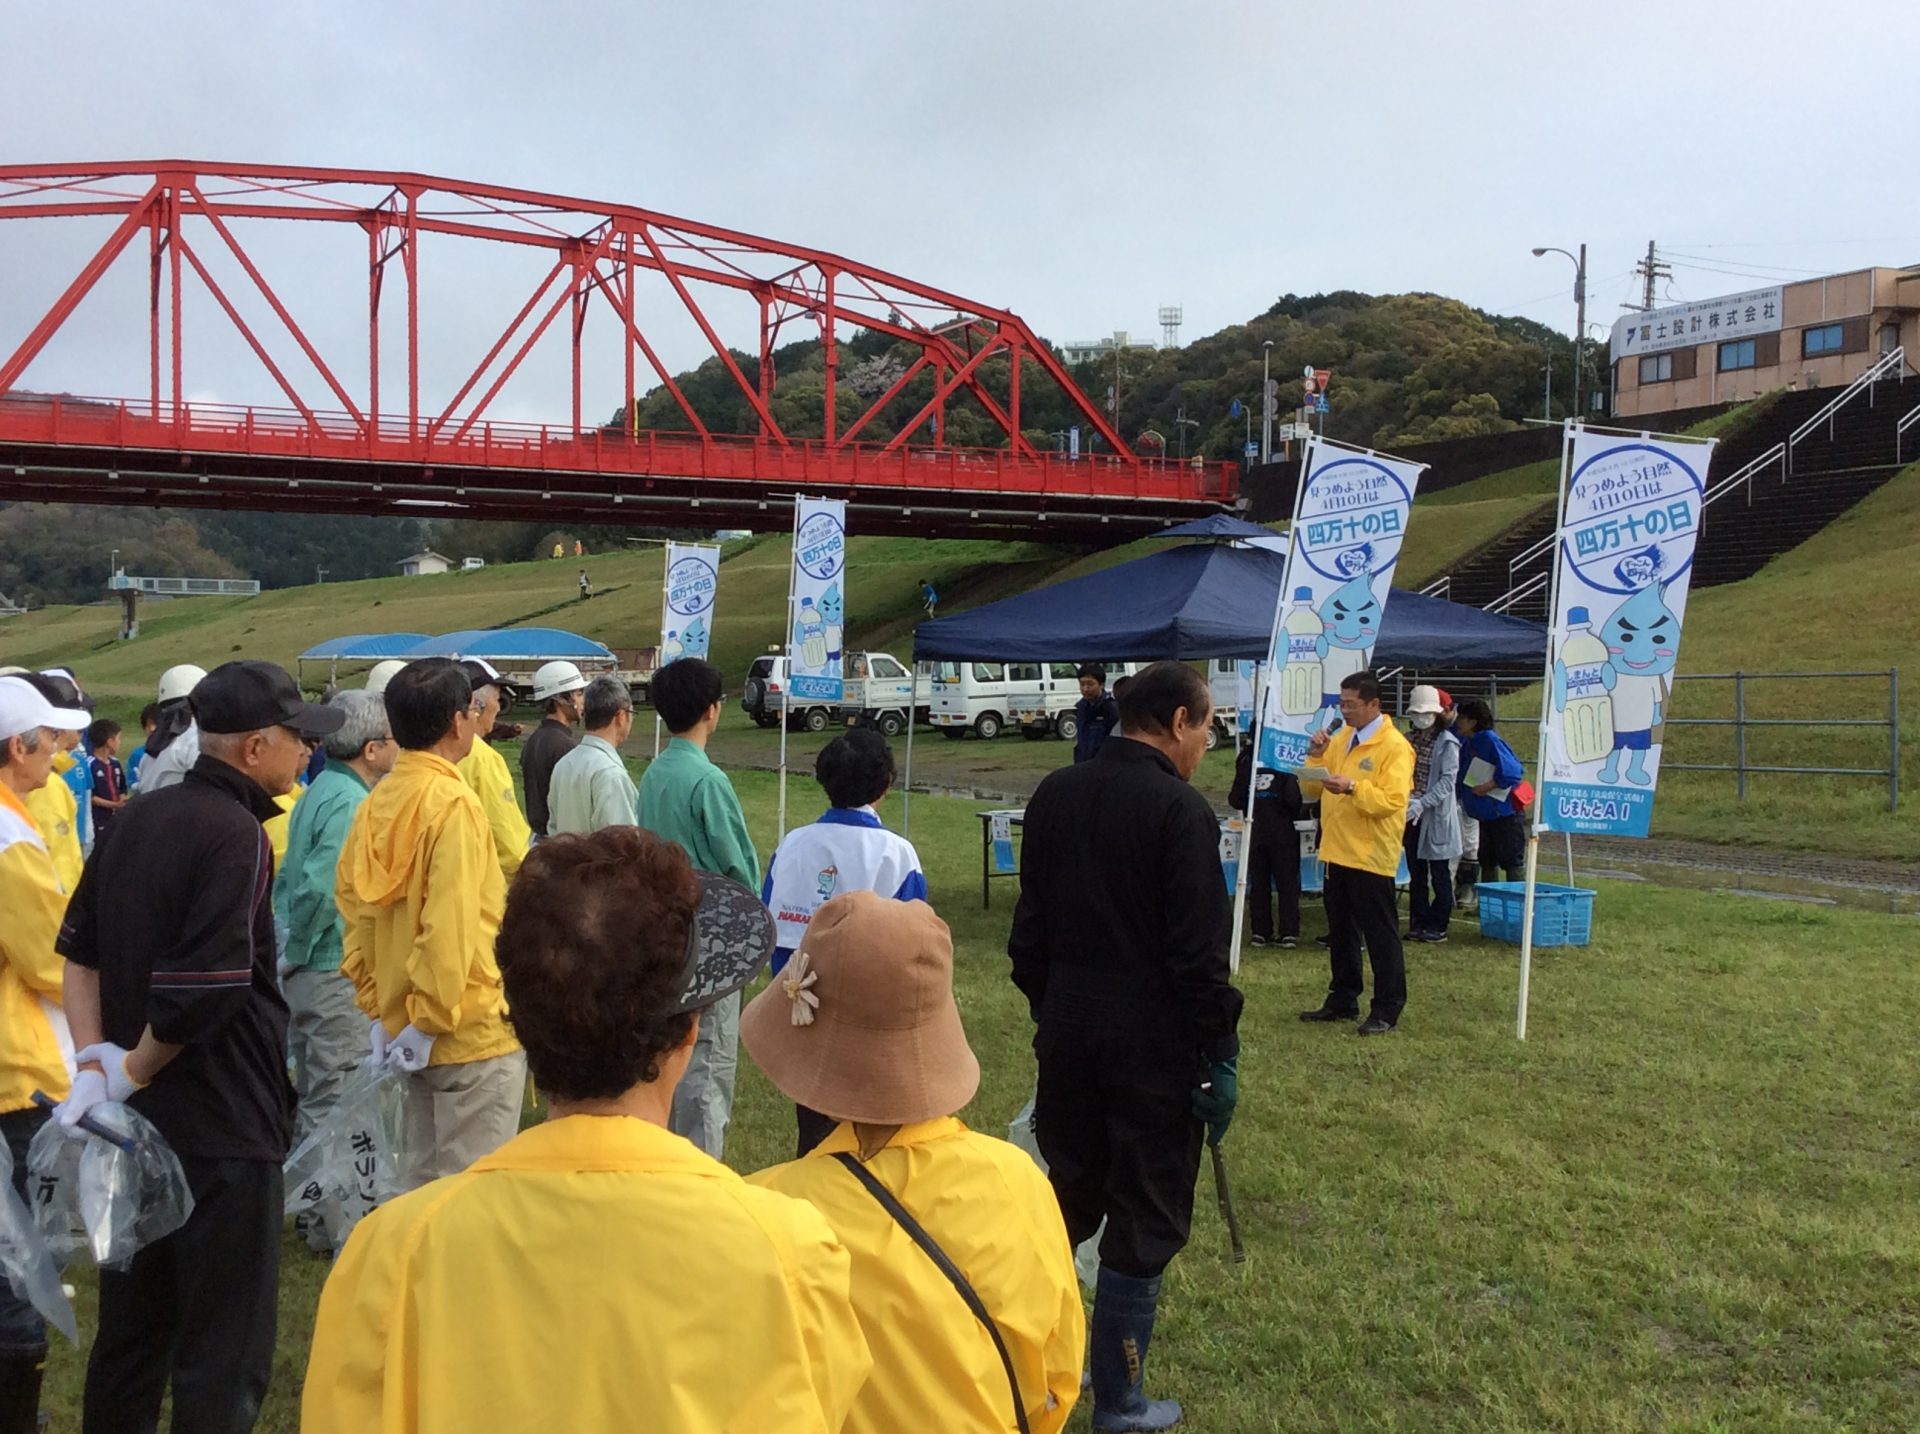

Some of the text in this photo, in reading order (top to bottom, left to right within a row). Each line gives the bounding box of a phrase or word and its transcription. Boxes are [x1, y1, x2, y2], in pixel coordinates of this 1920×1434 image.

[1575, 462, 1673, 500] 見つめよう自然
[1307, 508, 1400, 547] 四万十の日
[1575, 500, 1692, 558] 四万十の日
[802, 536, 842, 564] 四万十の日
[671, 577, 712, 602] 四万十の日
[1559, 797, 1630, 821] しまんとAI
